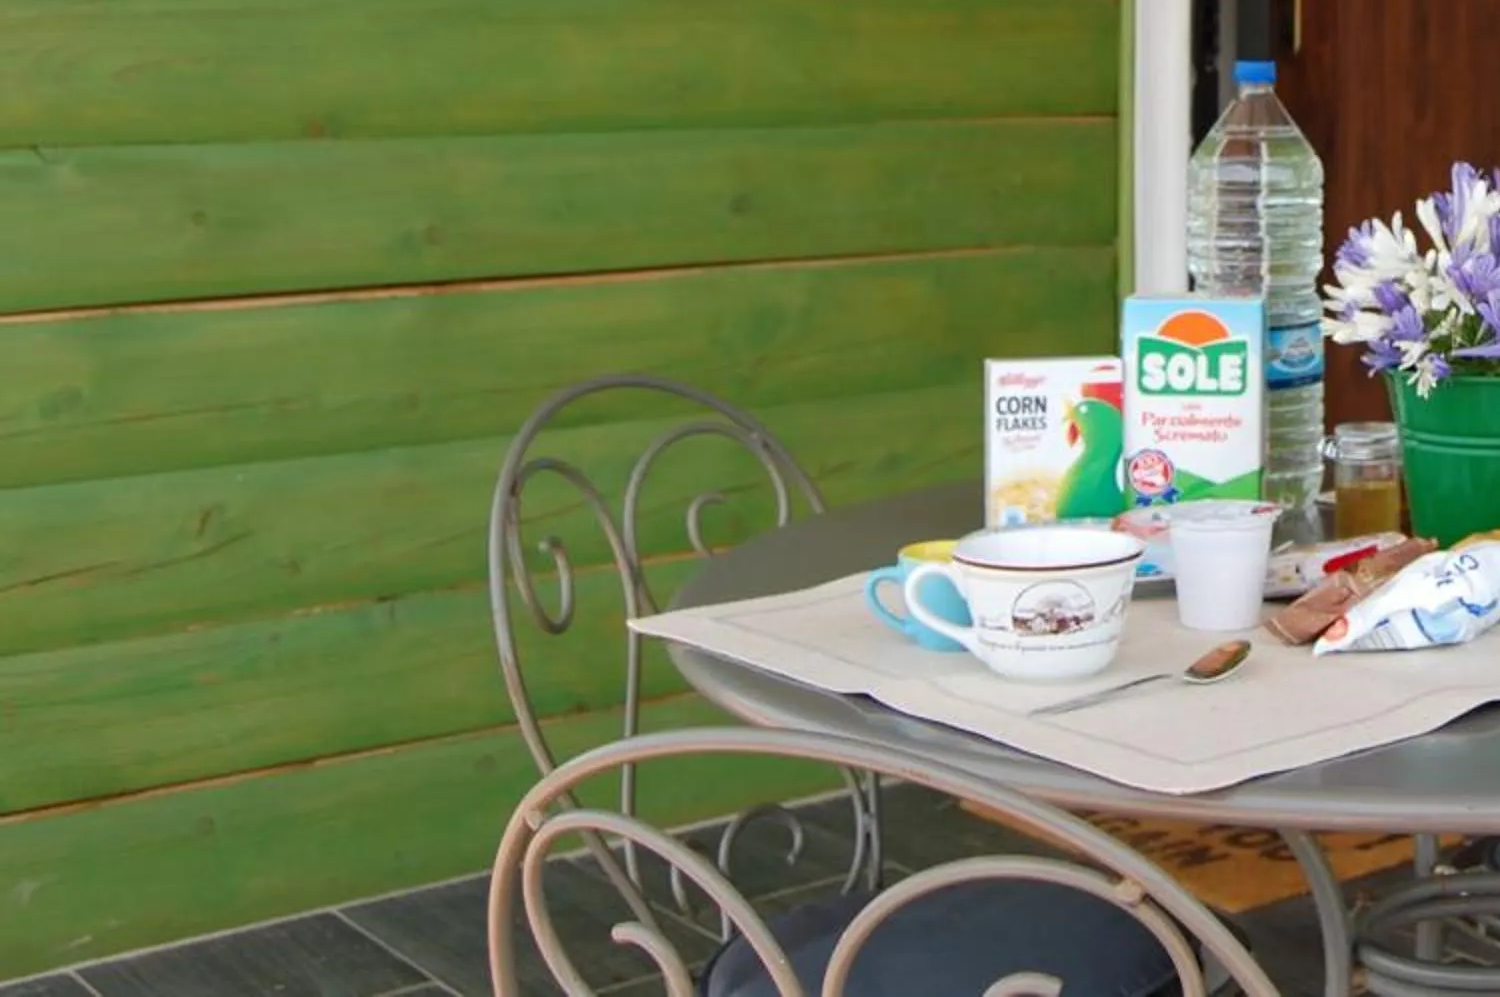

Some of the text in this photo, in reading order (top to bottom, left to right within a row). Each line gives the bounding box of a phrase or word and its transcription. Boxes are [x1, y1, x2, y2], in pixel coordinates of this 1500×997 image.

[1141, 352, 1243, 392] SOLE
[996, 394, 1047, 416] CORN
[996, 415, 1048, 432] FLAKES
